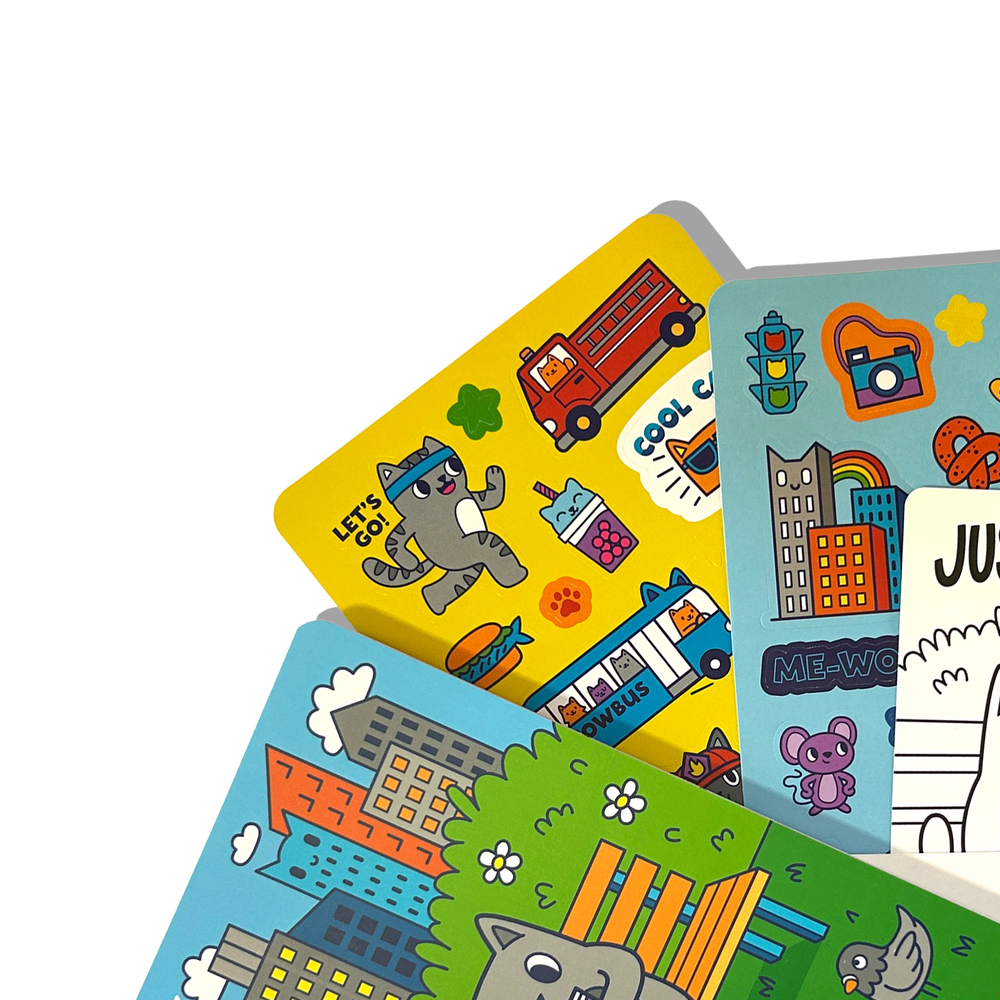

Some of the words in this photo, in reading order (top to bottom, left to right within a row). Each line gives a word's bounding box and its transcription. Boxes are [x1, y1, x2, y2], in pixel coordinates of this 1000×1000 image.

[633, 398, 693, 457] COOL
[691, 370, 714, 399] C
[332, 493, 382, 542] LET'S
[354, 512, 390, 547] GO!
[576, 681, 650, 738] OWBUS
